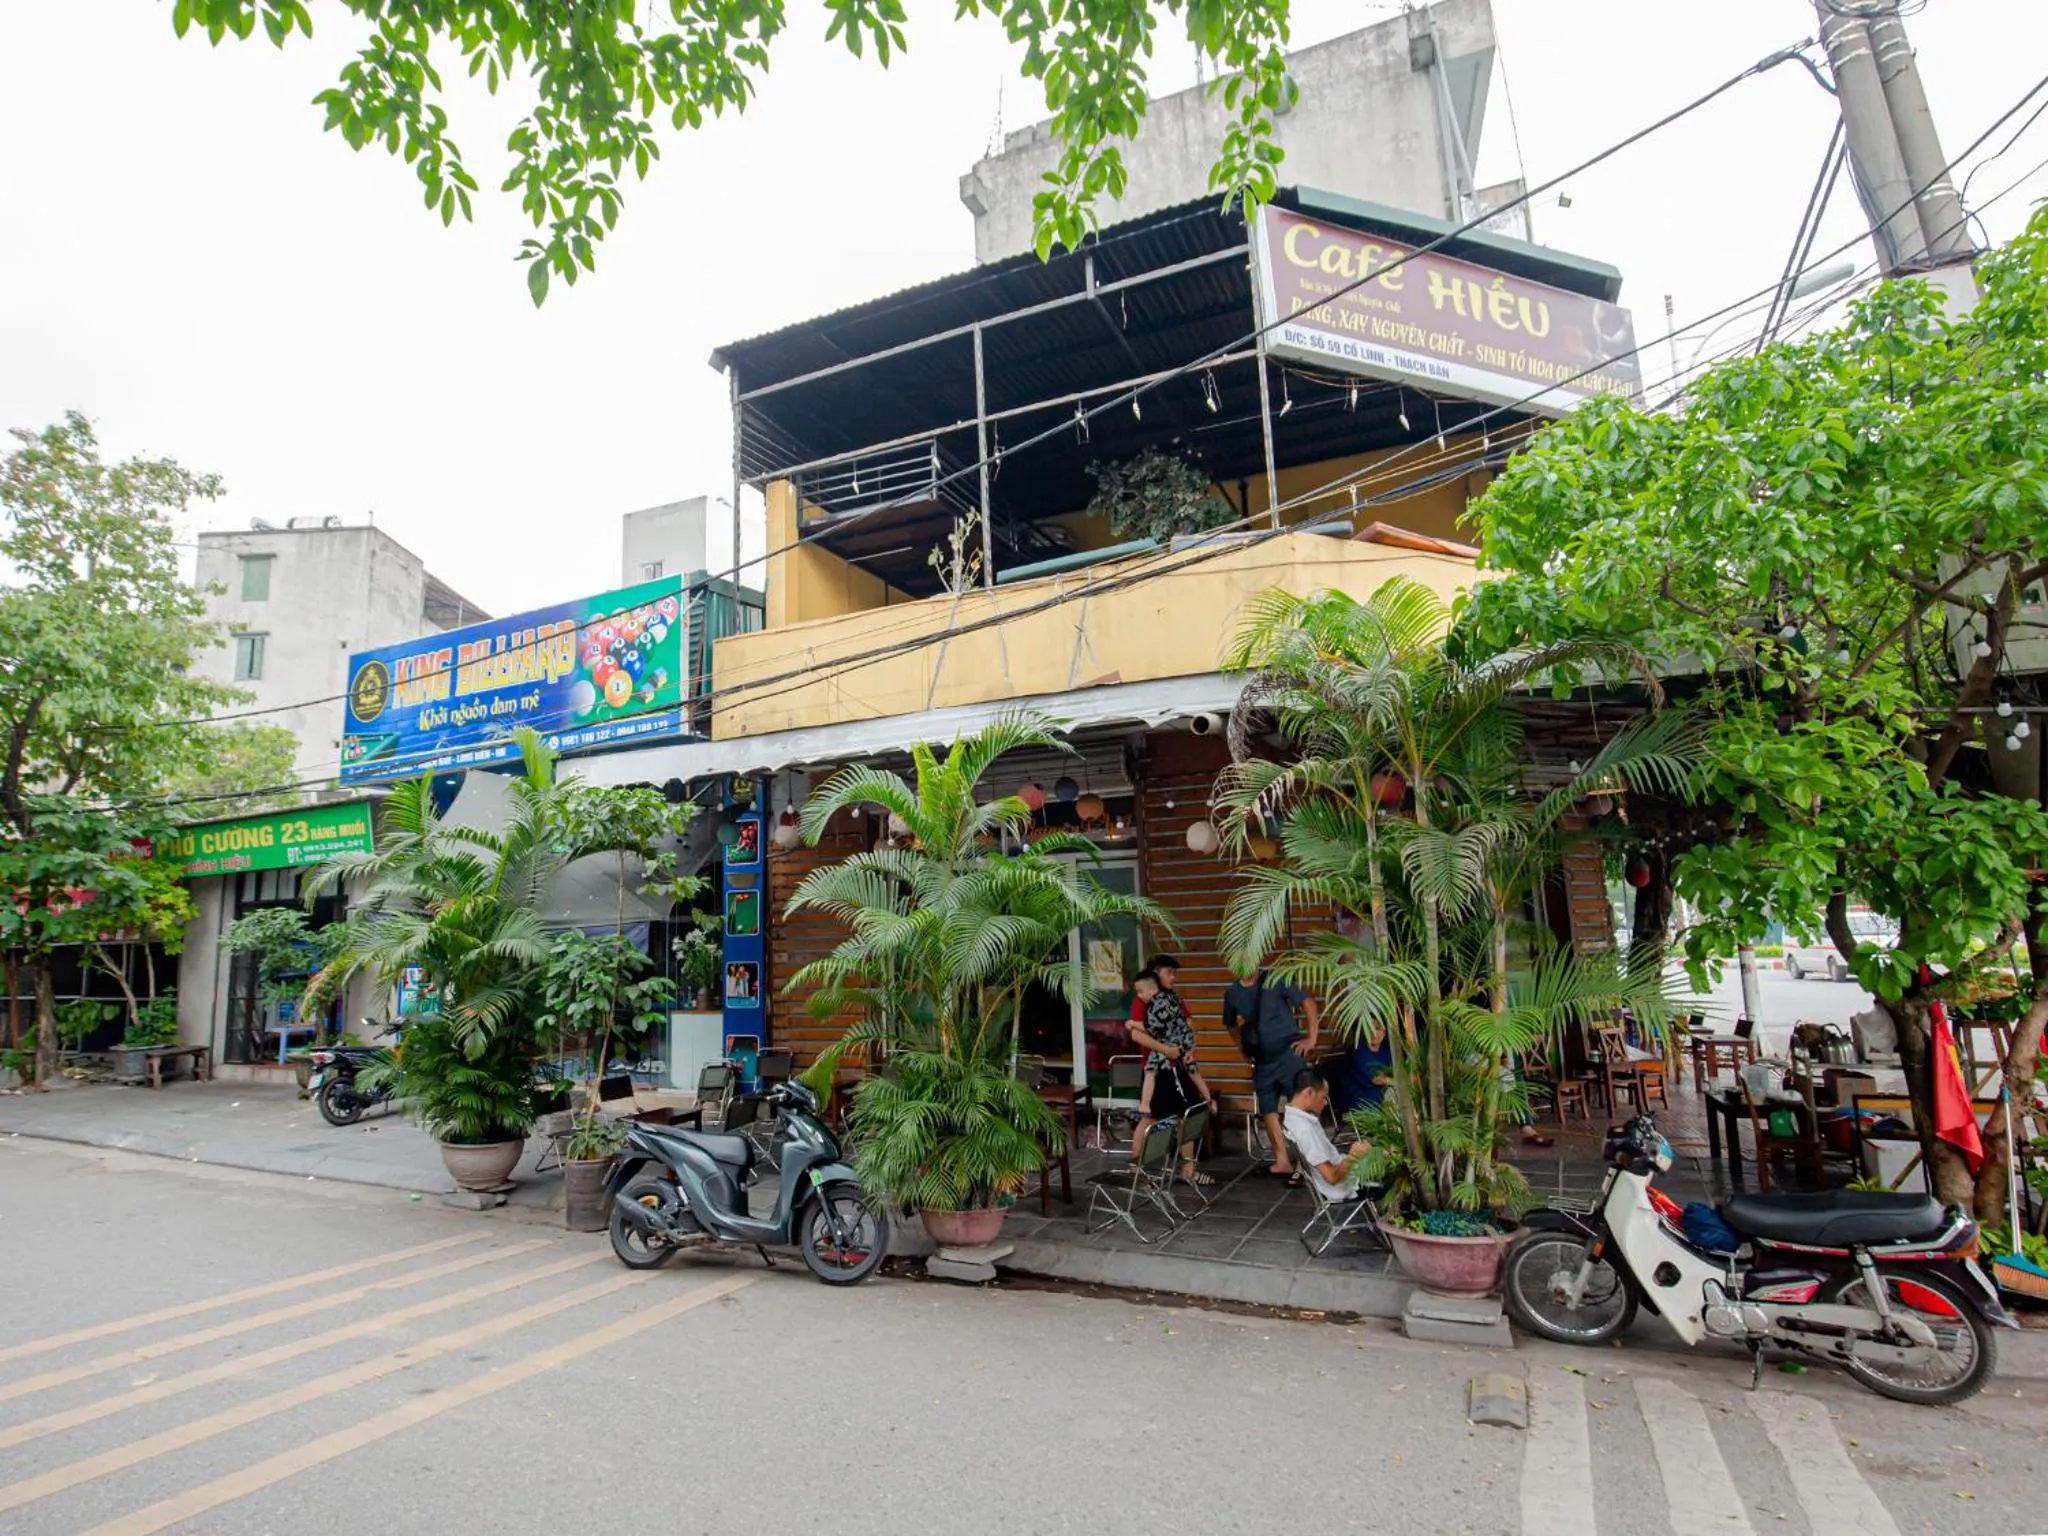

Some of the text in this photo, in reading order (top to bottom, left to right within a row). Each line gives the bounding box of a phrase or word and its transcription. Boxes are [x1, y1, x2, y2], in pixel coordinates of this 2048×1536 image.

[1339, 308, 1369, 332] XAY
[1475, 343, 1506, 370] SINH
[1529, 358, 1553, 379] HOA
[392, 647, 453, 709] KING
[281, 821, 308, 844] 23
